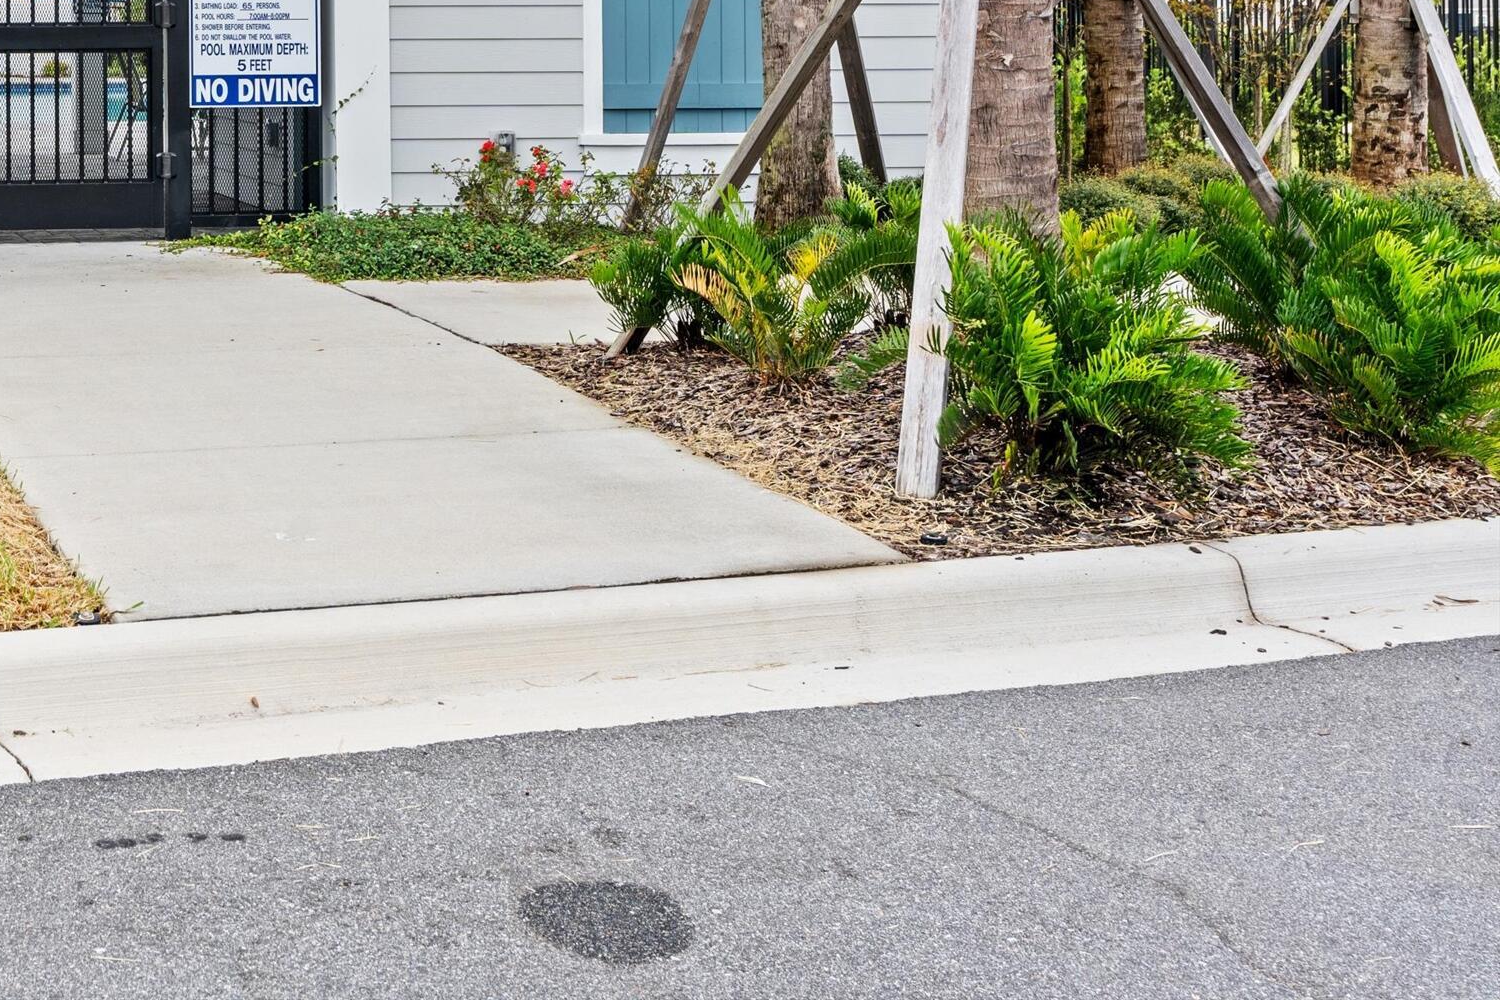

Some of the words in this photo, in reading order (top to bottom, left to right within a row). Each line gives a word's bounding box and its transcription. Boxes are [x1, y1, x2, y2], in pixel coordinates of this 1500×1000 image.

[201, 44, 226, 55] POOL
[229, 44, 273, 55] MAXIMUM
[277, 43, 309, 55] DEPTH:
[237, 59, 247, 72] 5
[250, 59, 272, 71] FEET
[196, 78, 229, 103] NO
[238, 77, 314, 102] DIVING
